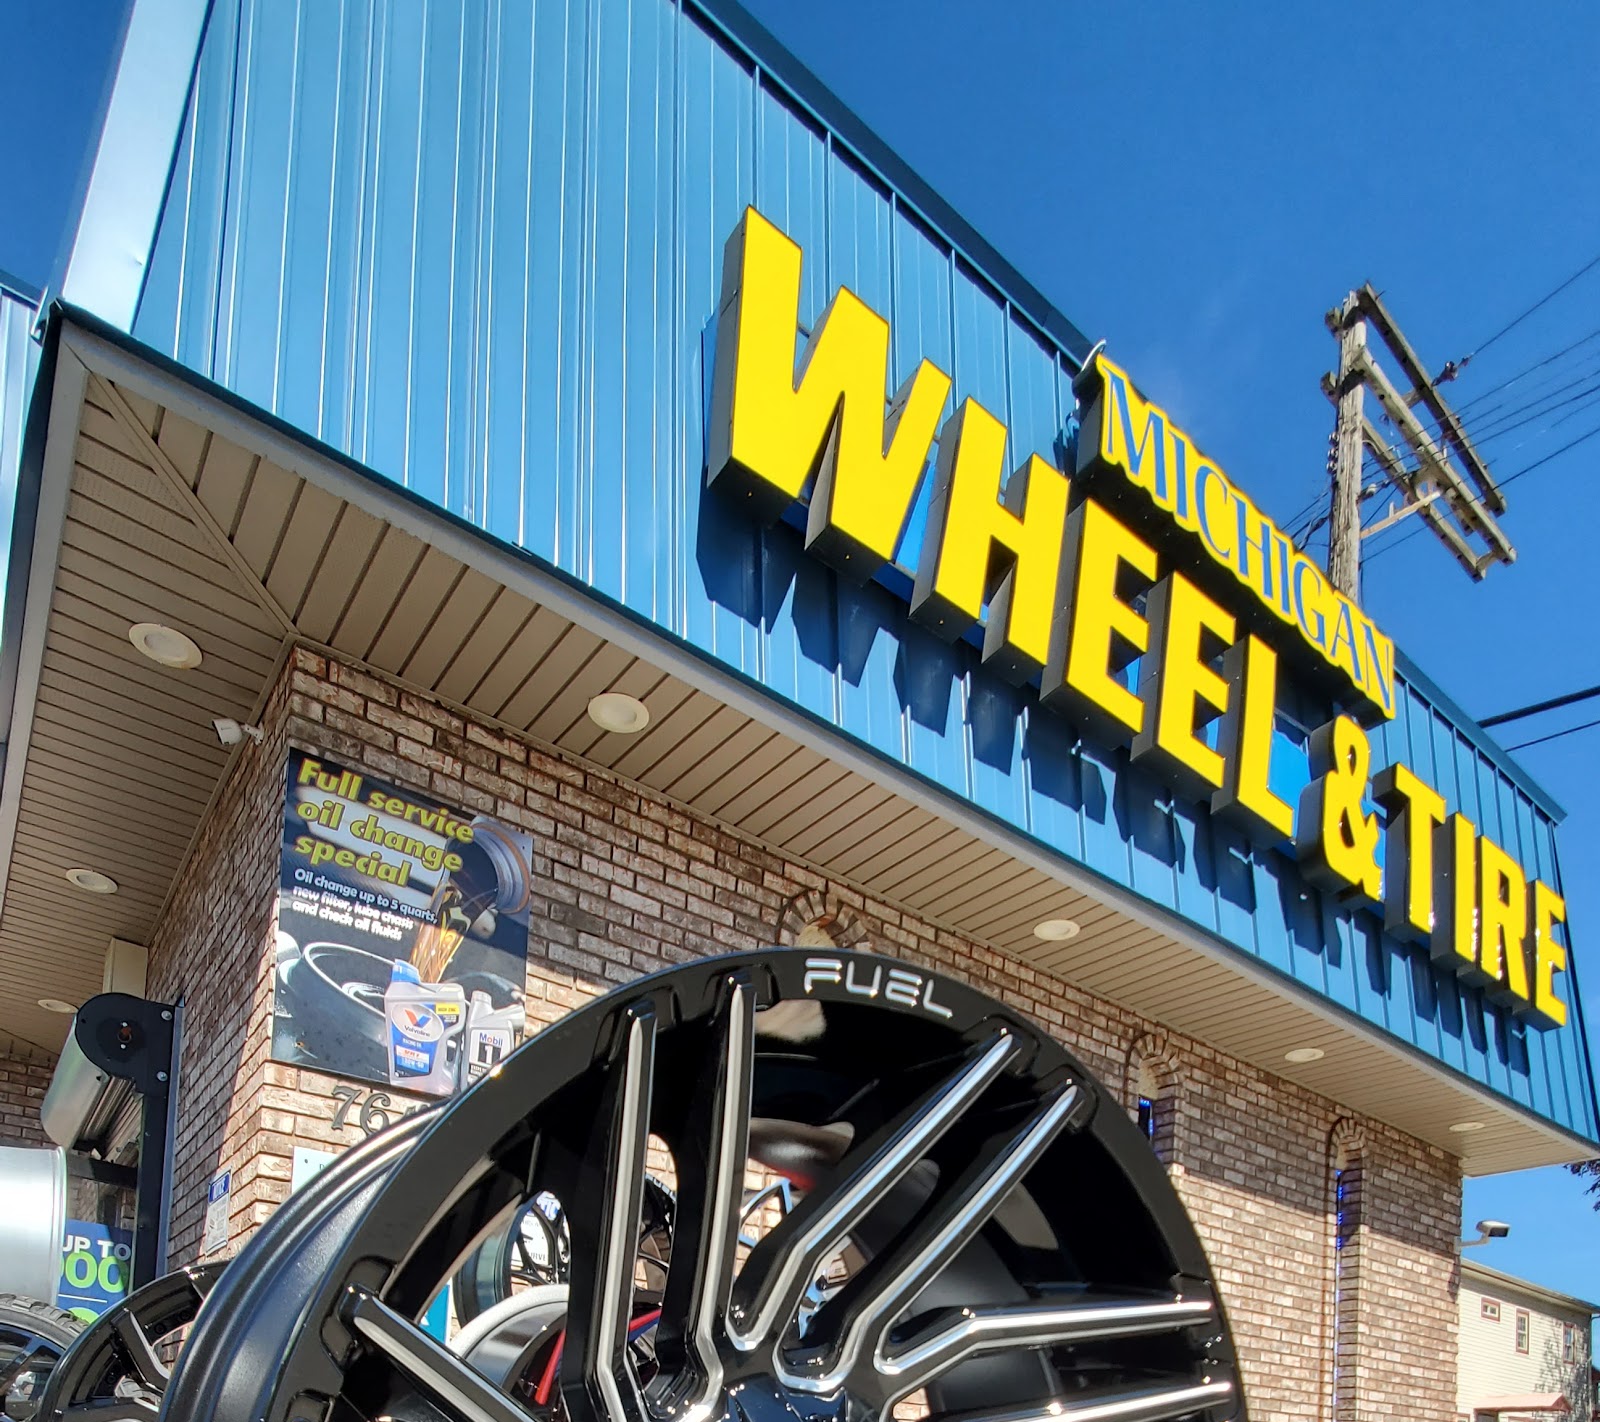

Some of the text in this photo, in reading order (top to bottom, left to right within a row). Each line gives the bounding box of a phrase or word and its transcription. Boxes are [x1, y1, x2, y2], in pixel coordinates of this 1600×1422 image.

[1102, 362, 1394, 715] MICHIGAN
[728, 206, 1567, 1029] WHEEL & TIRE
[297, 758, 475, 843] Full service
[294, 835, 412, 888] special
[296, 800, 463, 872] oil change
[292, 900, 319, 916] and
[319, 906, 354, 927] check
[371, 920, 403, 941] fluids
[293, 885, 320, 901] new
[321, 891, 353, 913] filter,
[353, 901, 381, 919] lube
[294, 868, 438, 924] Oil change up to 5 quarts,
[804, 957, 953, 1019] FUEL
[404, 1025, 431, 1037] Valvoline
[479, 1032, 503, 1046] Mobil
[331, 1085, 428, 1136] 76
[60, 1251, 129, 1293] 00
[98, 1240, 131, 1261] TO
